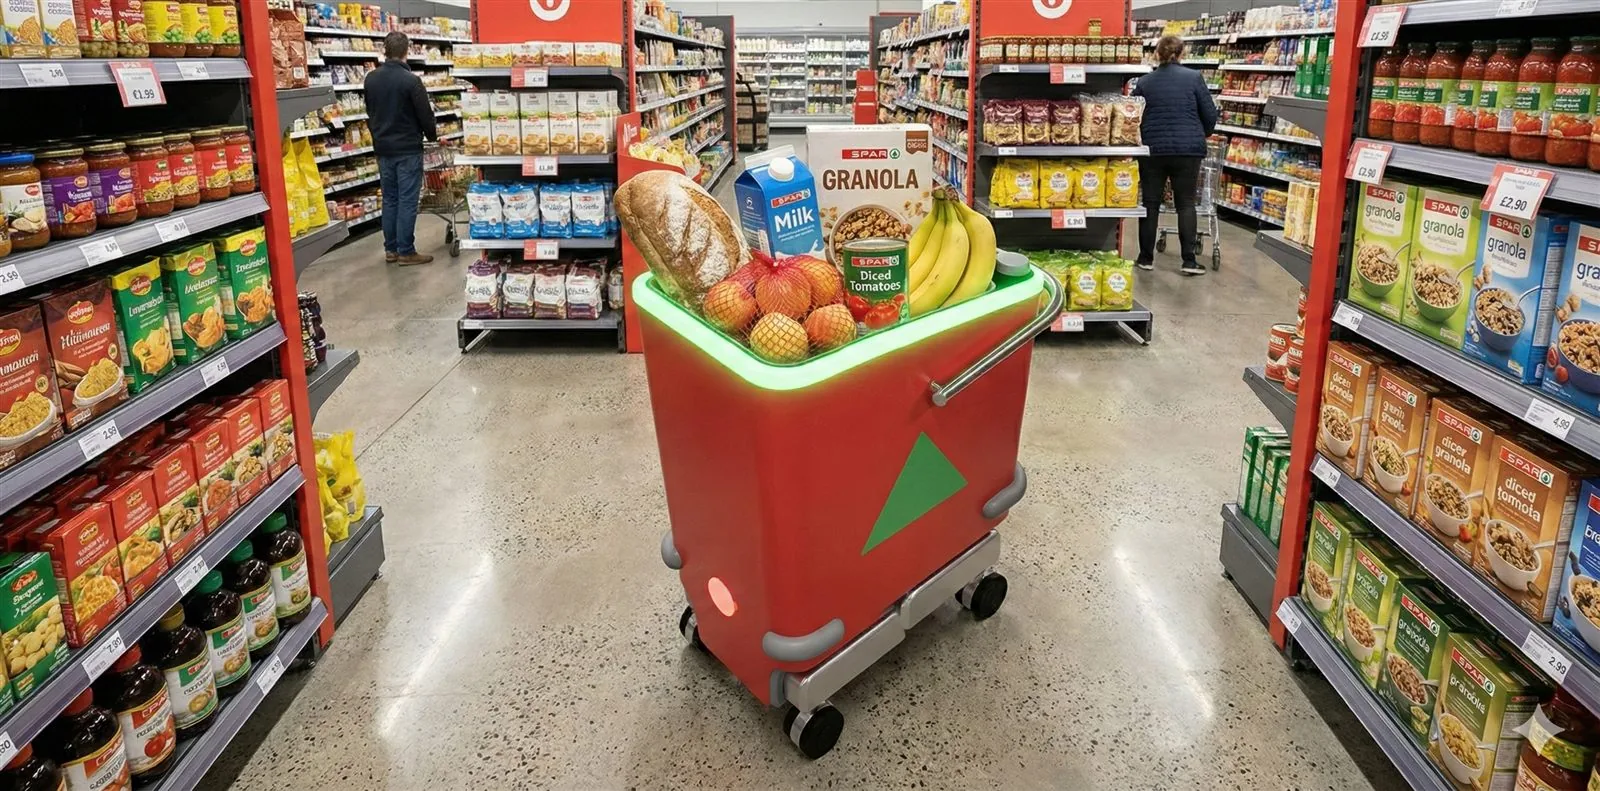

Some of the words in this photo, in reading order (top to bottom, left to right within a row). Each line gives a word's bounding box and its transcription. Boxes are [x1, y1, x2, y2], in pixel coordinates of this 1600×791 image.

[851, 150, 887, 158] SPAR
[822, 169, 919, 190] GRANOLA
[1372, 188, 1396, 200] SPAR
[774, 206, 815, 232] Milk
[1365, 204, 1401, 221] granola
[1431, 202, 1459, 216] SPAR
[1423, 219, 1465, 238] granola
[1496, 217, 1521, 233] SPAR
[1487, 237, 1527, 260] granola
[860, 269, 892, 280] Diced
[850, 280, 901, 292] Tomatoes
[1386, 381, 1408, 401] SPAR
[1443, 414, 1471, 437] SPAR
[1435, 445, 1472, 475] granola
[1507, 453, 1540, 478] SPAR
[1505, 477, 1537, 503] diced
[1406, 601, 1432, 628] SPAR
[1458, 656, 1485, 684] SPAR
[1548, 656, 1567, 675] 2.99
